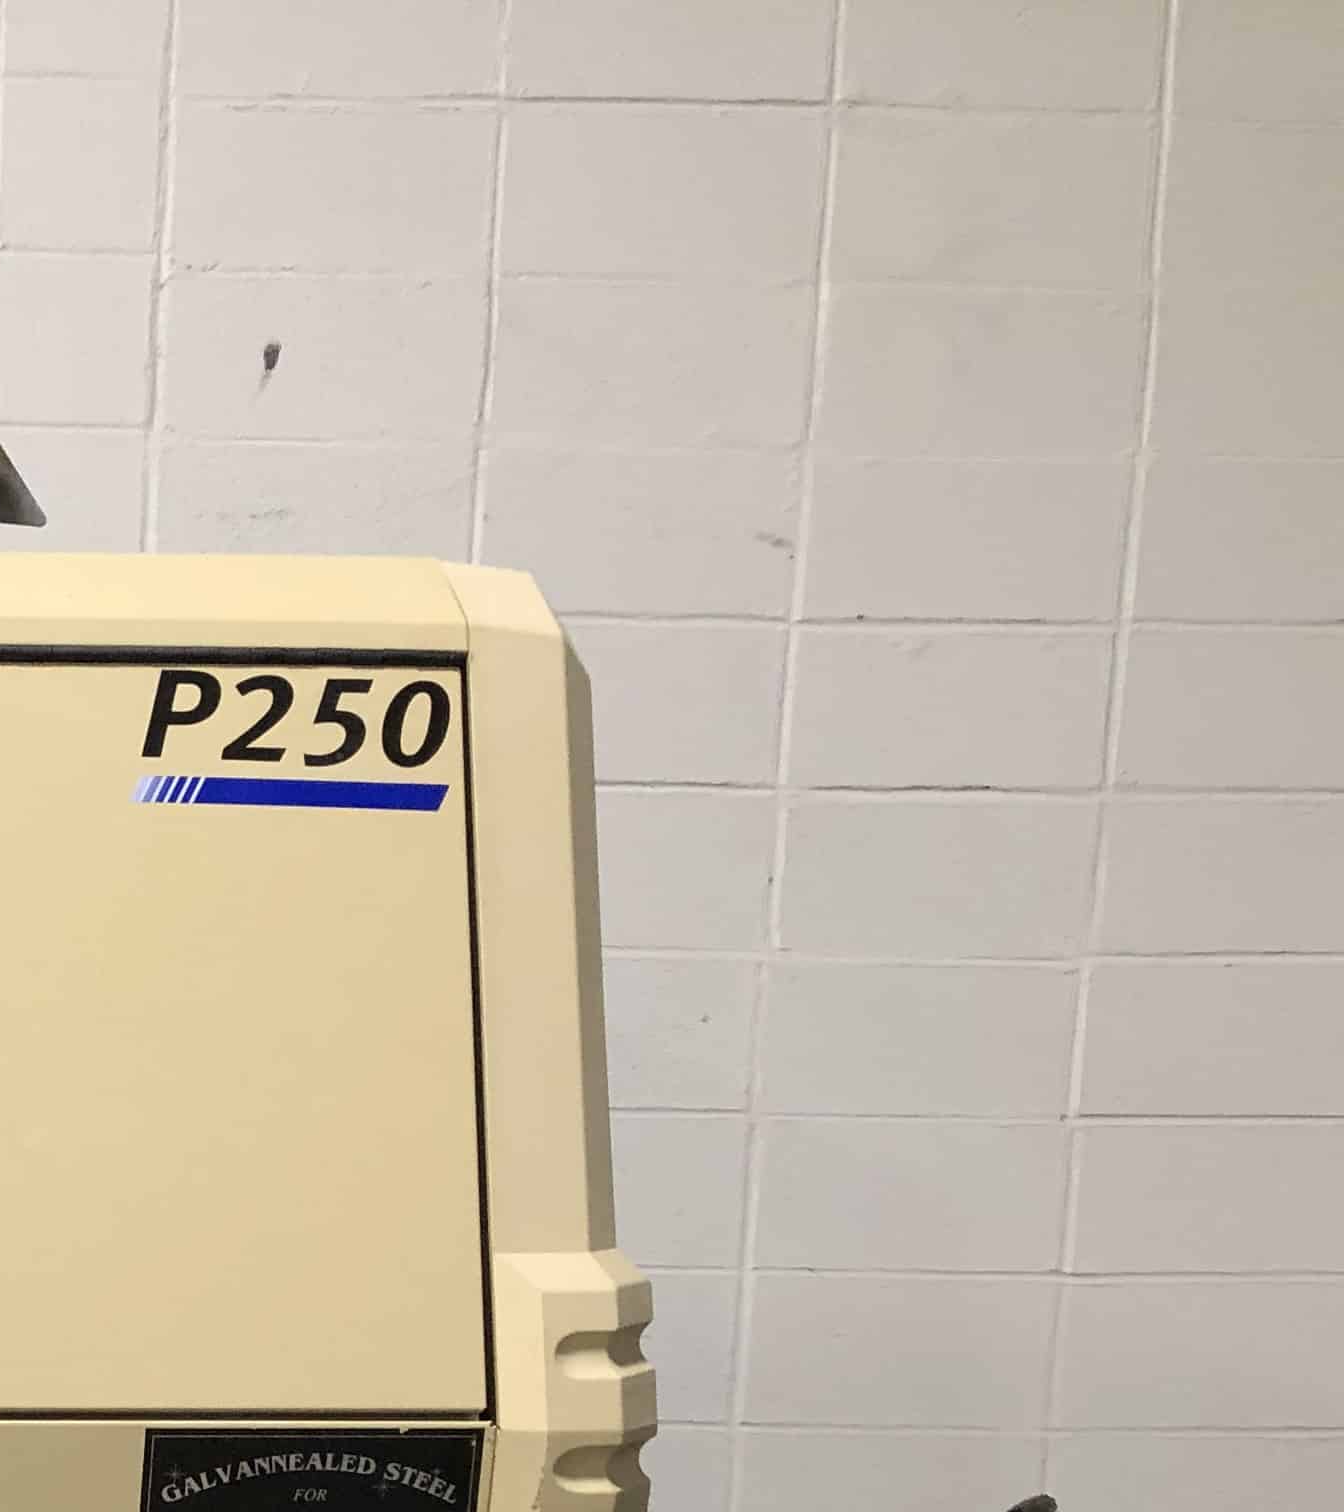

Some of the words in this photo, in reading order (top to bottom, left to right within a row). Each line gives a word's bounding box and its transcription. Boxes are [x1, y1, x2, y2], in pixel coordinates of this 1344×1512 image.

[141, 669, 451, 768] P250
[160, 1452, 377, 1503] GALVANNEALED
[382, 1462, 457, 1504] STEEL
[292, 1487, 328, 1502] FOR
